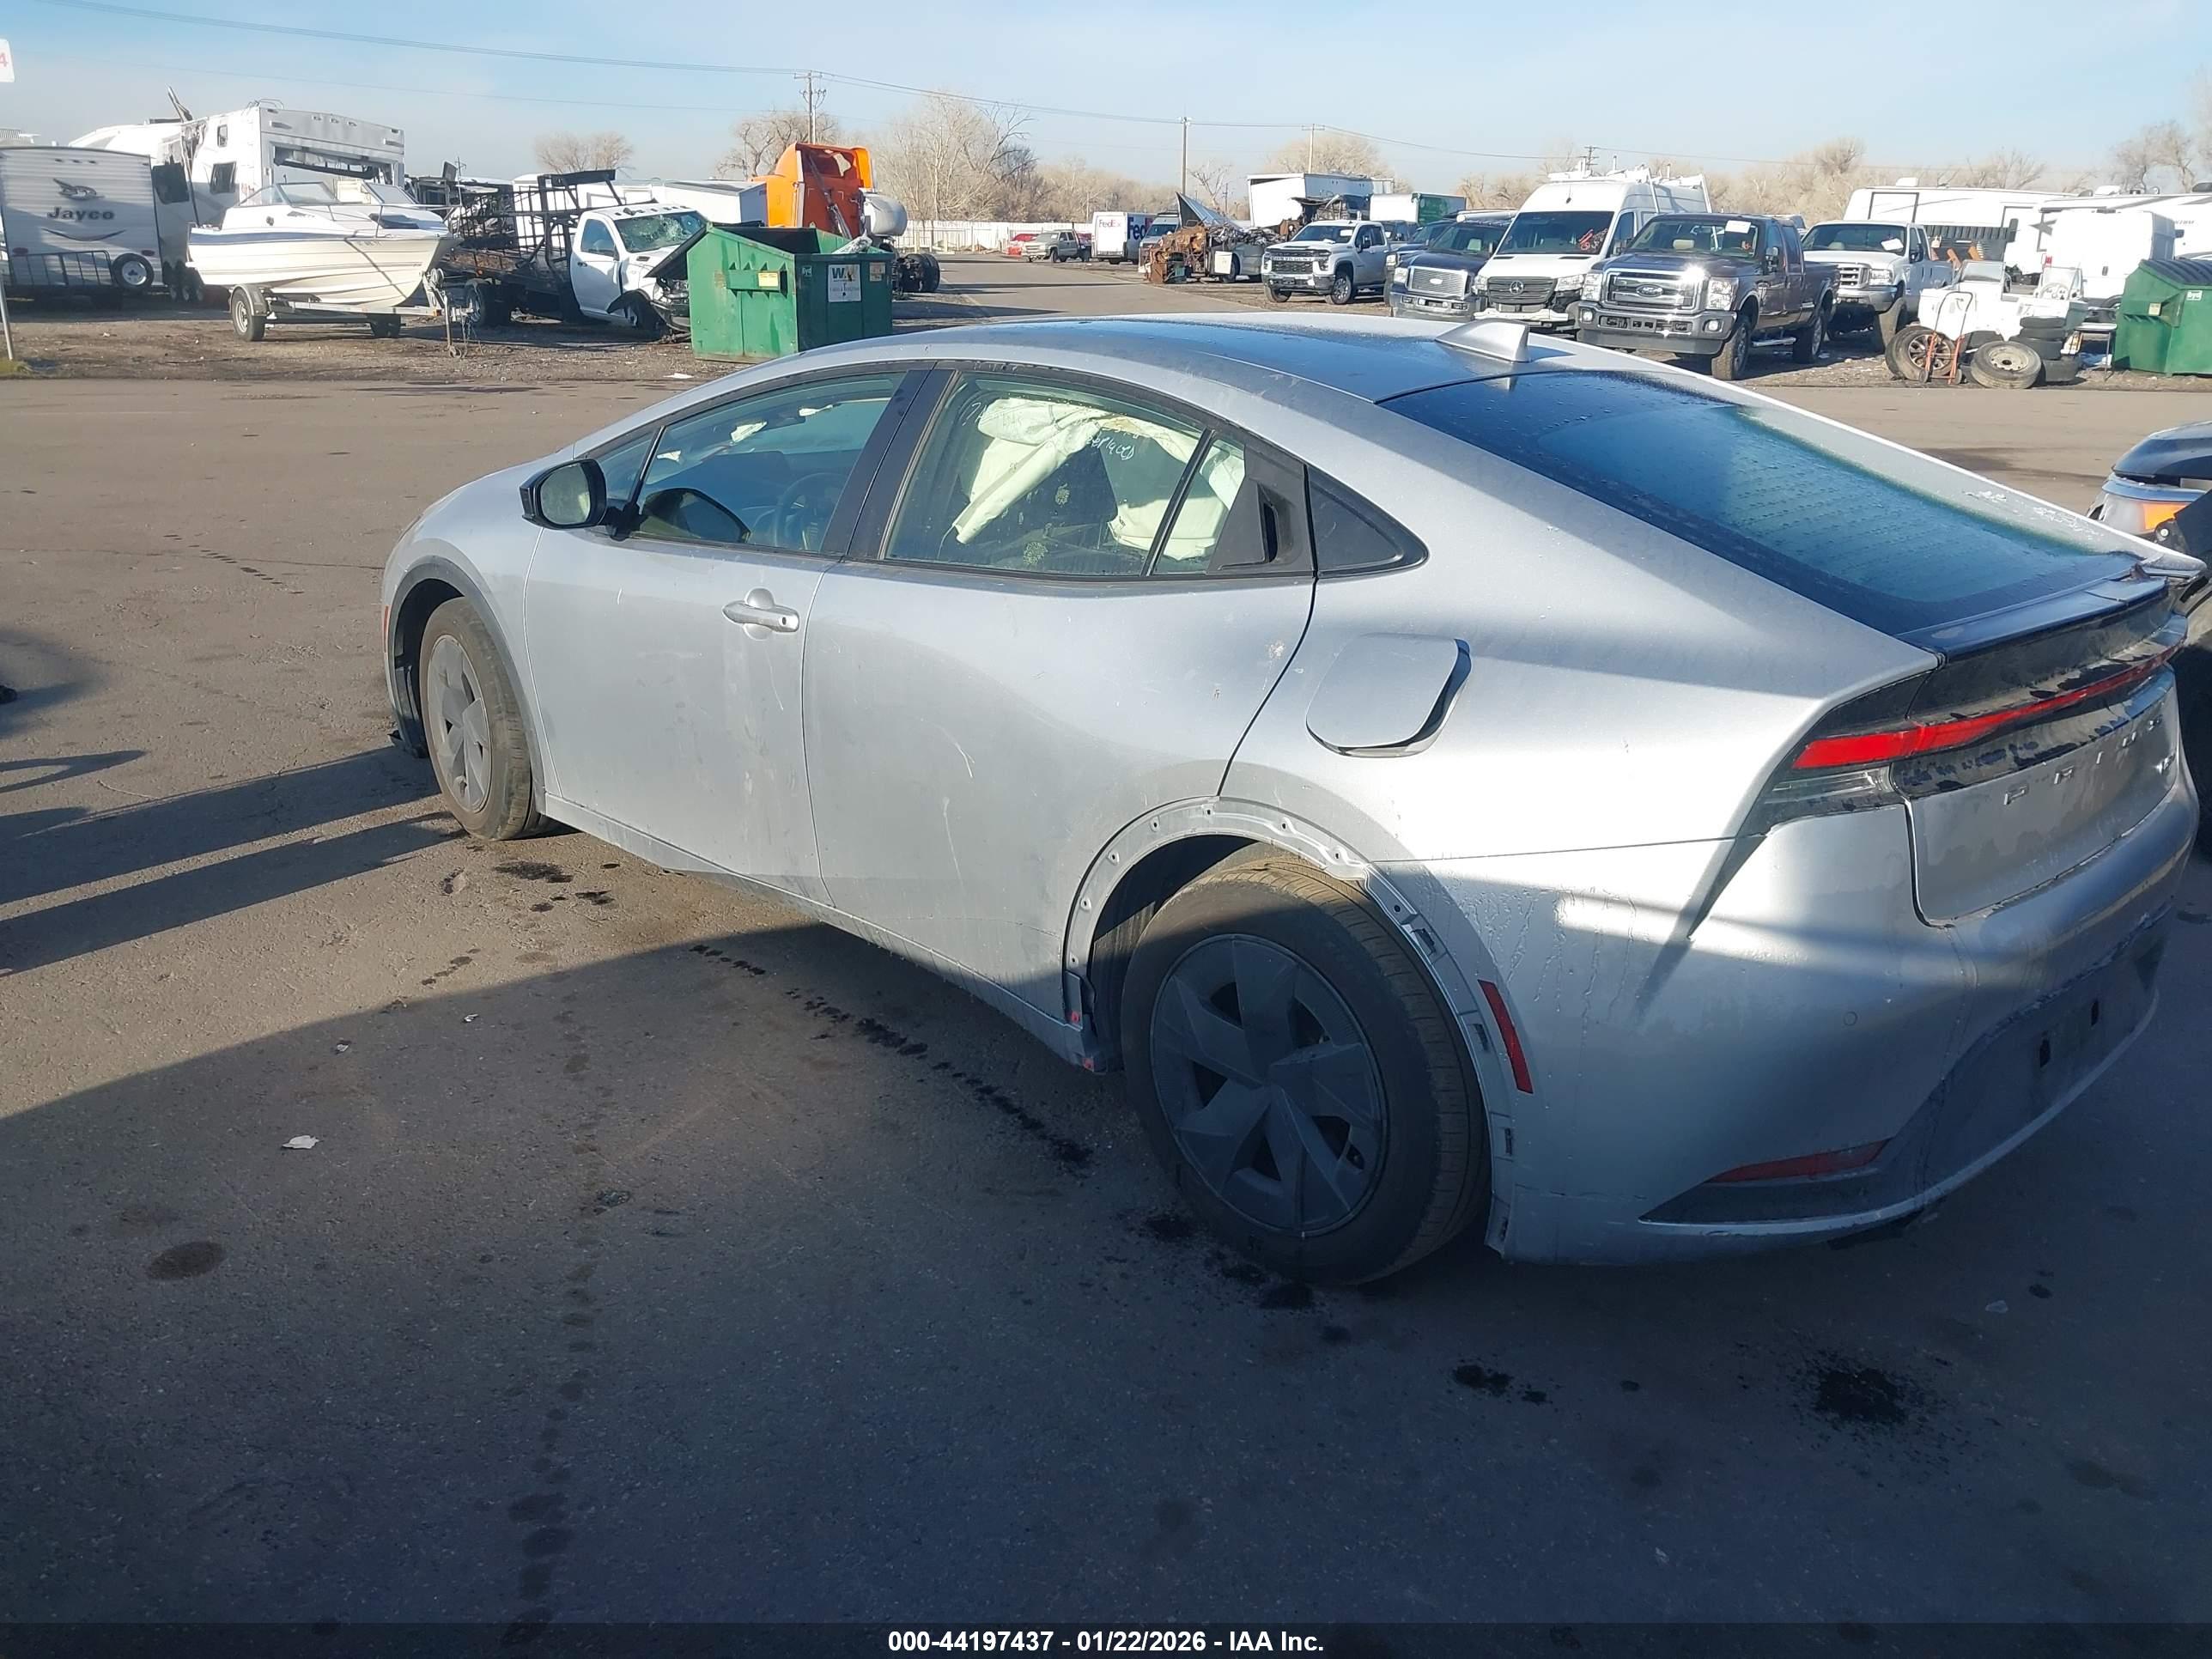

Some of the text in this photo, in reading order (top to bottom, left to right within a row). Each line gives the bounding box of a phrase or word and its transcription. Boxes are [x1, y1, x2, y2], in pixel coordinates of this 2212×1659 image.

[46, 206, 115, 223] Jayco
[1099, 219, 1121, 228] FedEx
[1127, 216, 1153, 240] Fed
